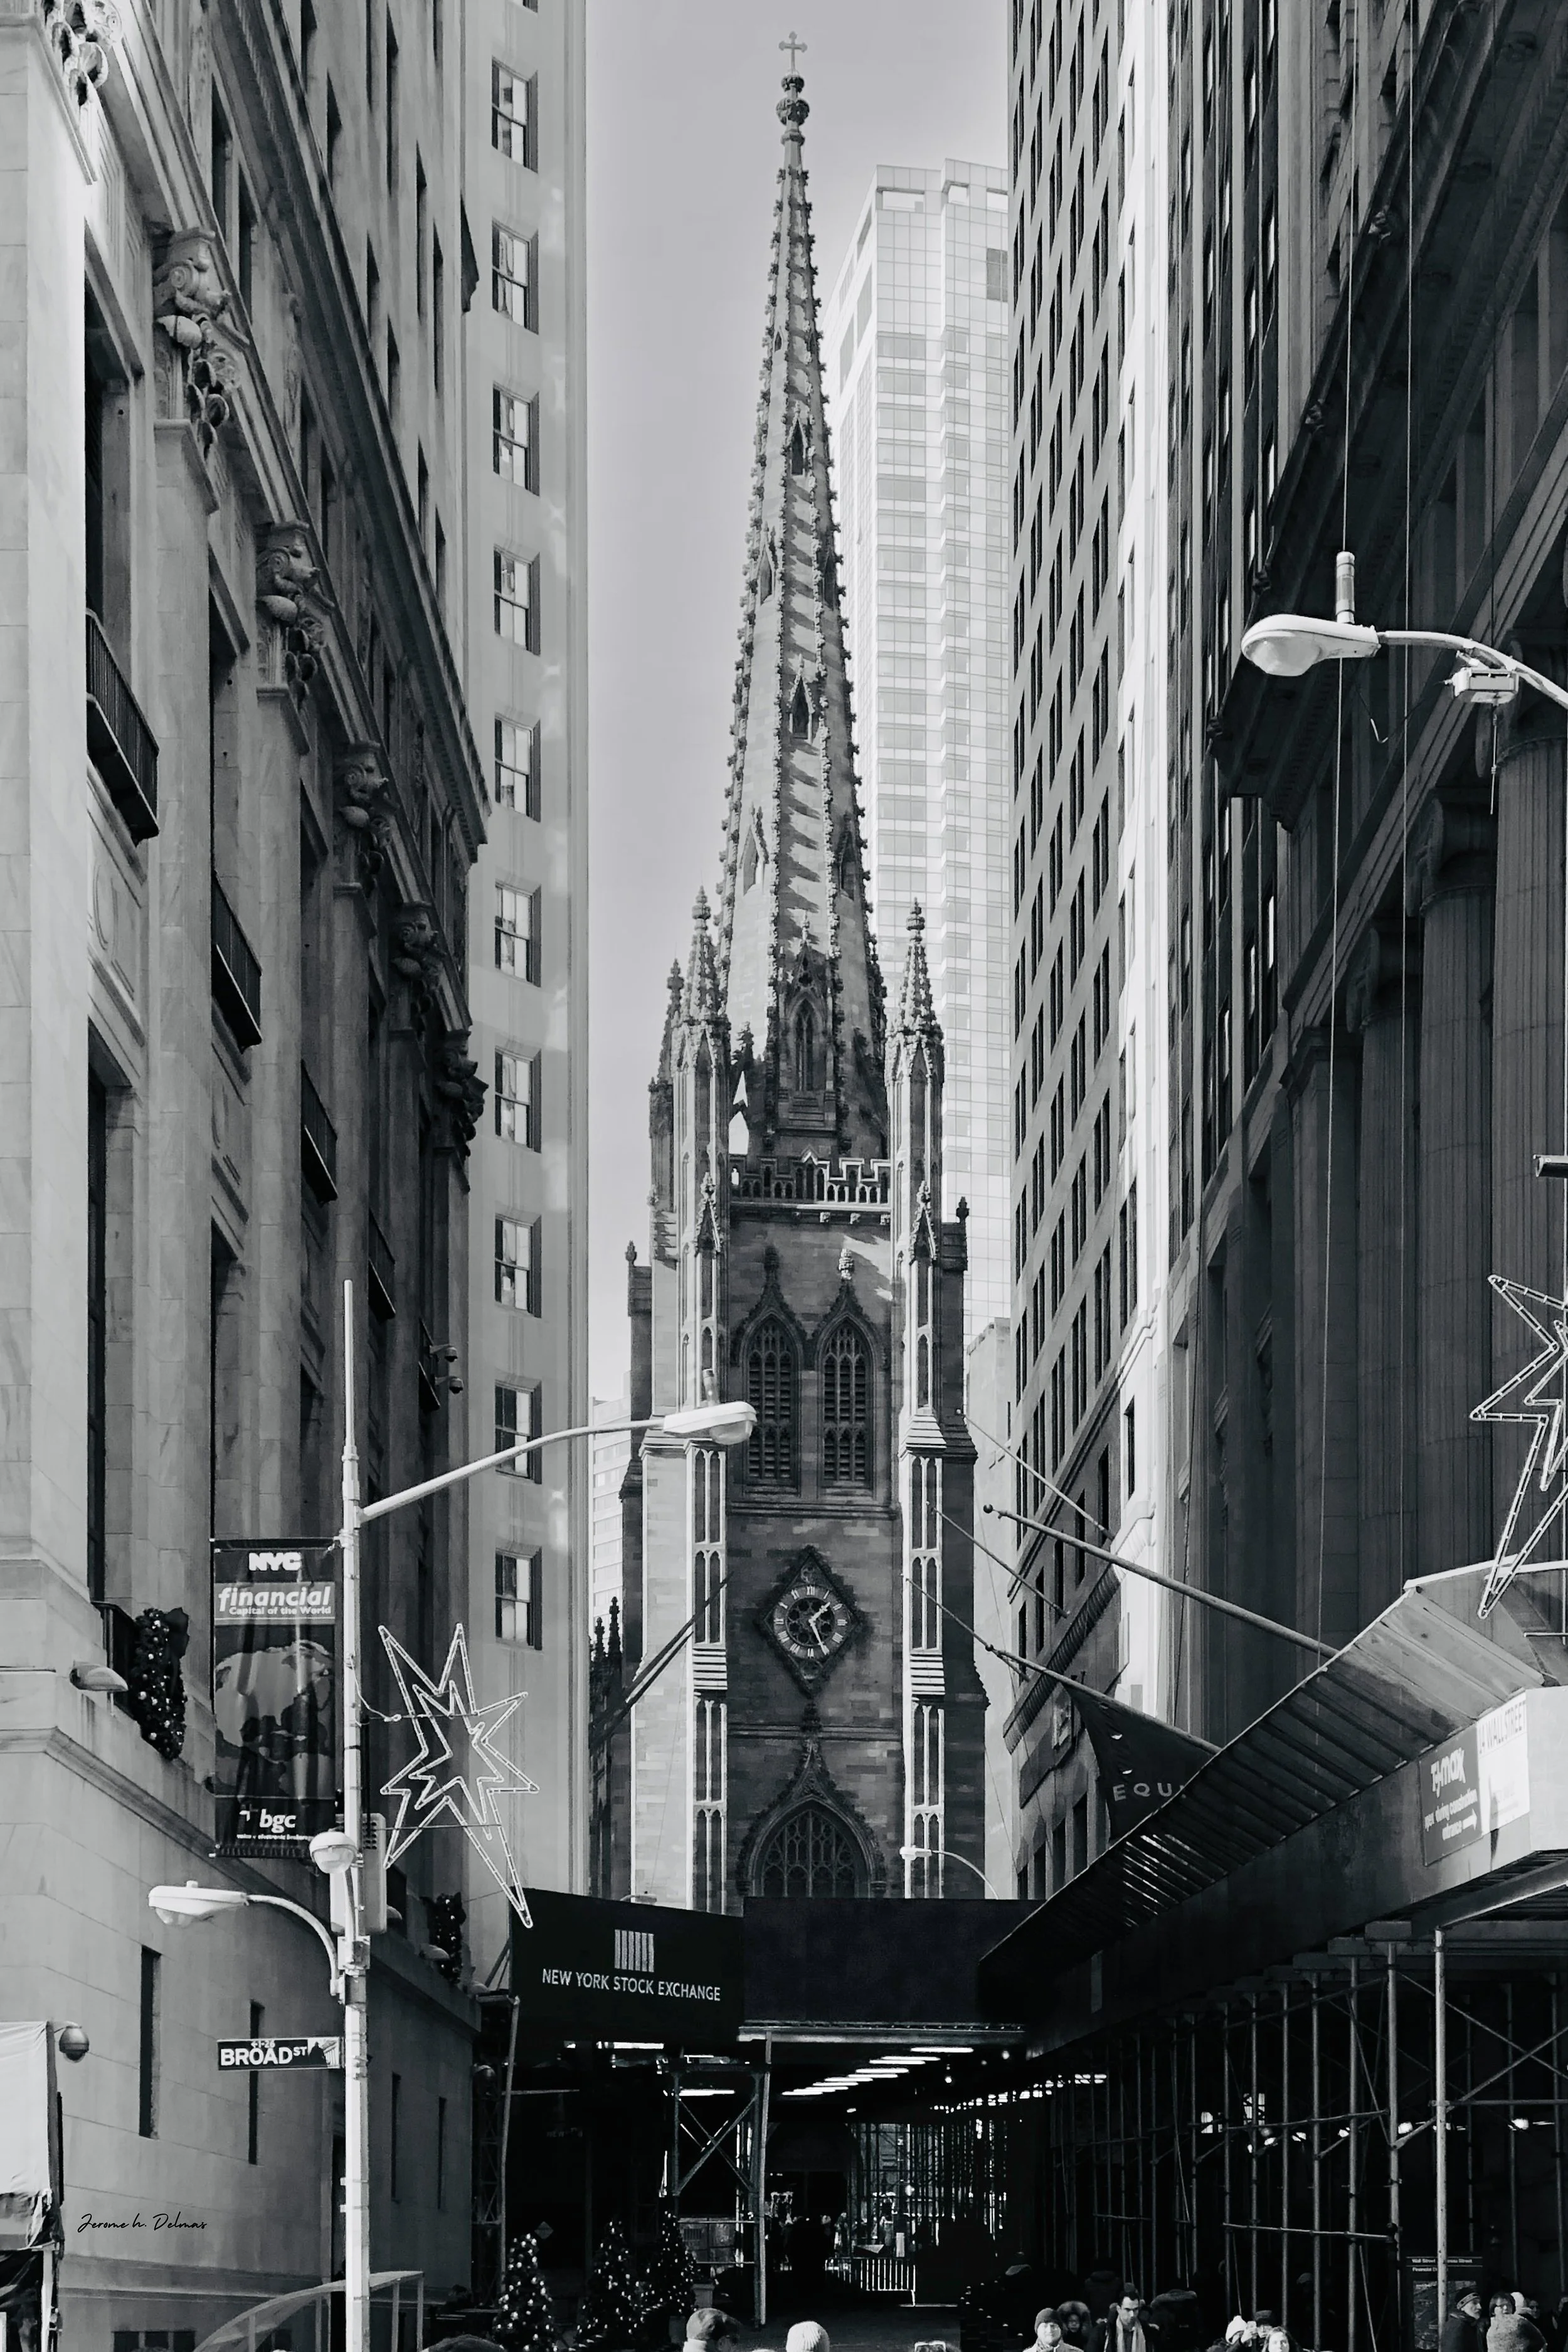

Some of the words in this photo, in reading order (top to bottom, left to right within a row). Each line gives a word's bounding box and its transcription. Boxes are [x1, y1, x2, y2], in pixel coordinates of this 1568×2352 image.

[248, 1552, 302, 1571] NYC
[218, 1586, 331, 1612] financial
[229, 1606, 265, 1616] Capital
[267, 1606, 278, 1614] of
[280, 1606, 297, 1614] the
[300, 1606, 332, 1614] World
[1486, 1714, 1505, 1749] WALL
[1505, 1700, 1527, 1740] STREET
[1113, 1783, 1185, 1802] EQU
[259, 1808, 297, 1833] bgc
[542, 1968, 572, 1986] NEW
[576, 1972, 610, 1990] YORK
[613, 1976, 654, 1994] STOCK
[658, 1981, 721, 2001] EXCHANGE
[221, 2047, 293, 2066] BROAD
[293, 2047, 307, 2057] ST
